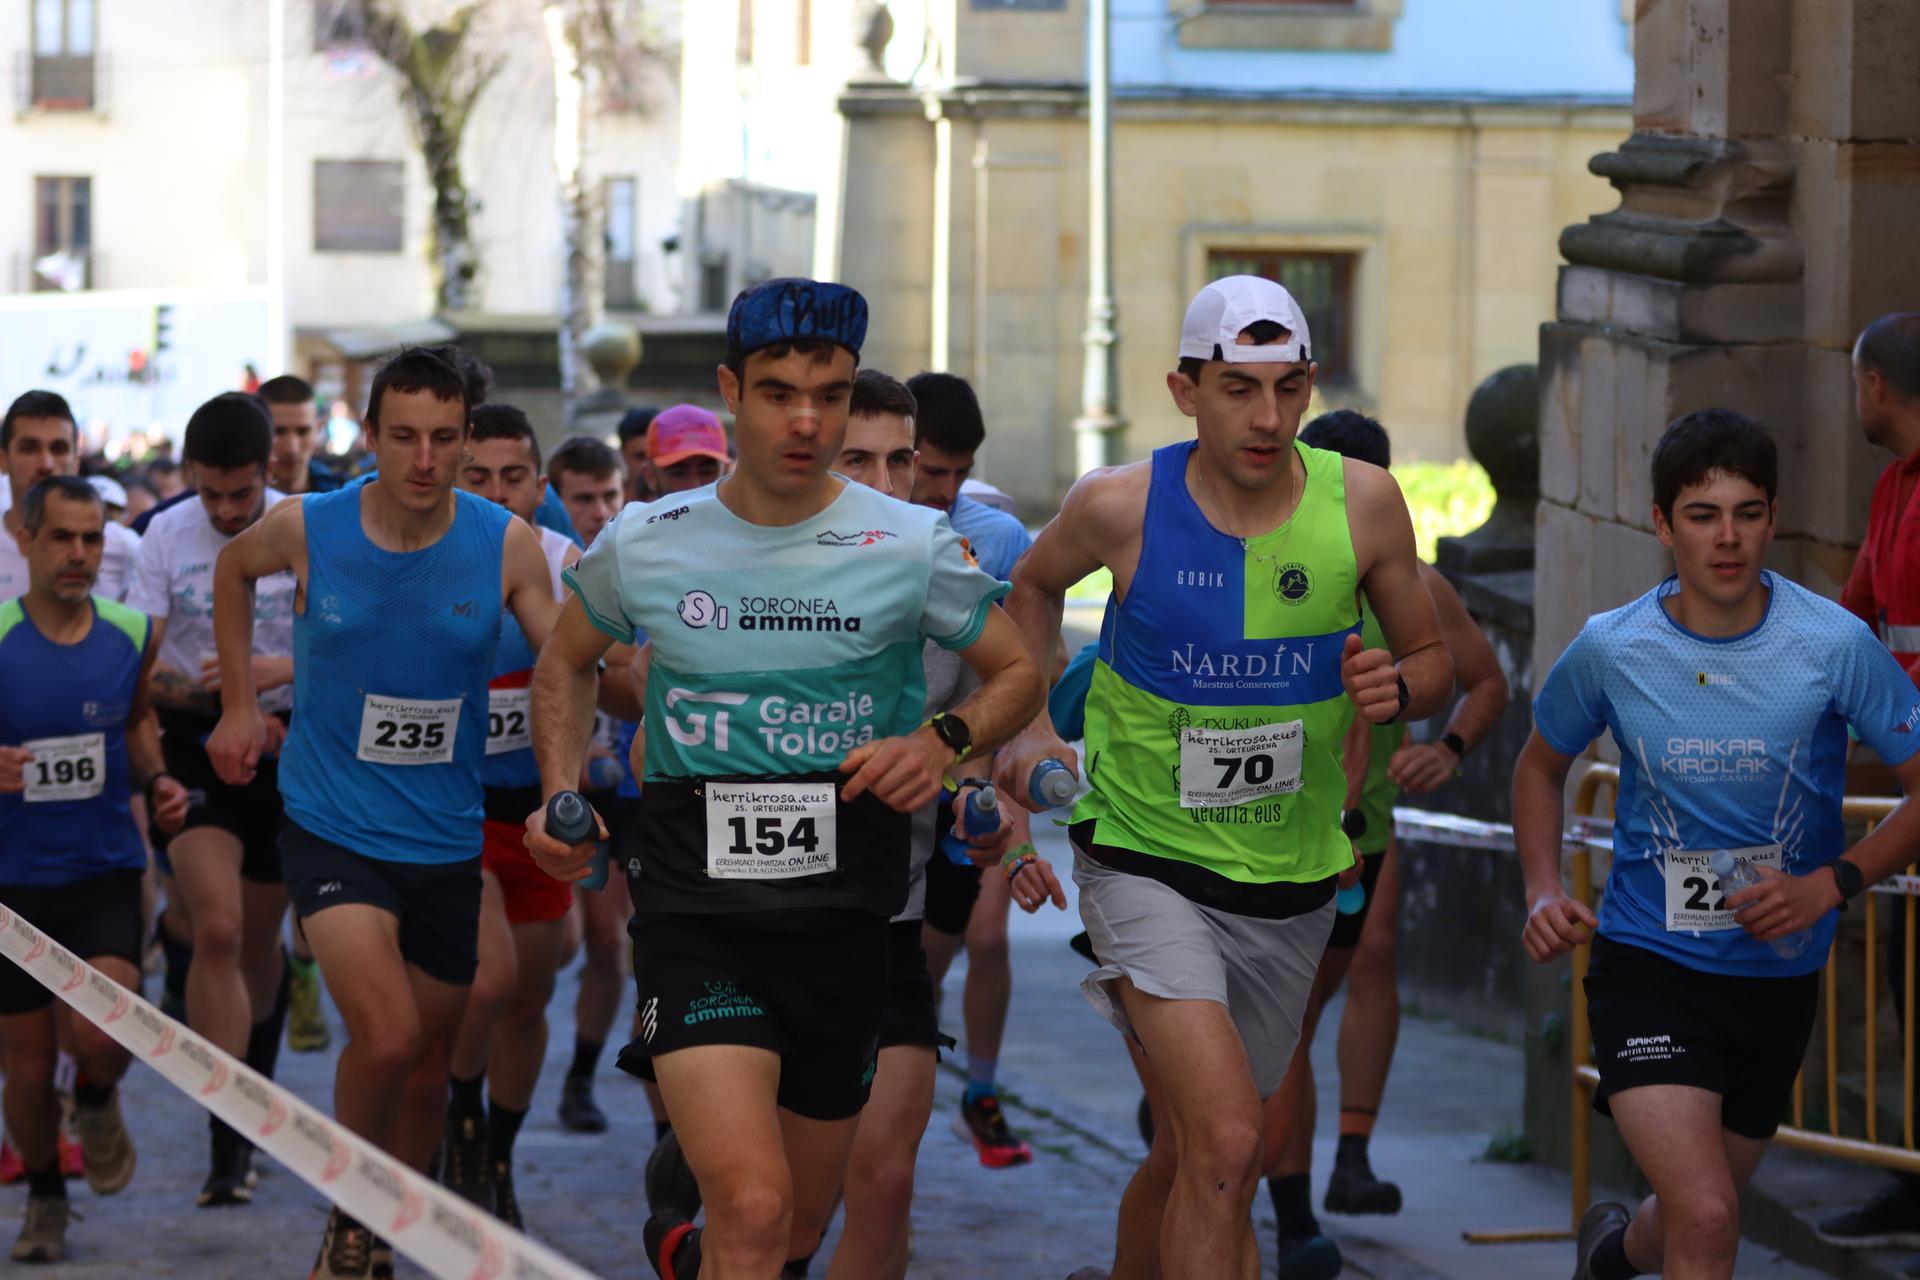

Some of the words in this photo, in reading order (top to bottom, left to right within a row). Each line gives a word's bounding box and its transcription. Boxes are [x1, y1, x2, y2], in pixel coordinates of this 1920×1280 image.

[659, 506, 690, 520] negua
[1177, 570, 1223, 587] GOBIK
[739, 597, 838, 614] SORONEA
[738, 614, 861, 632] ammma
[1192, 679, 1234, 689] Maestros
[1235, 680, 1290, 689] Conserveros
[759, 692, 874, 725] Garaje
[488, 710, 525, 738] 02
[374, 720, 446, 750] 235
[758, 724, 874, 756] Tolosa
[1188, 731, 1297, 746] herrikrosa.eus
[1226, 742, 1278, 753] URTEURRENA
[1666, 738, 1766, 755] GAIKAR
[36, 757, 95, 786] 196
[1213, 754, 1274, 789] 70
[1660, 756, 1771, 774] KIROLAK
[1275, 778, 1296, 790] LINE
[713, 789, 829, 804] herrikrosa.eus
[728, 816, 819, 856] 154
[788, 857, 805, 867] ON
[807, 853, 830, 863] LINE
[683, 1005, 765, 1025] ammma
